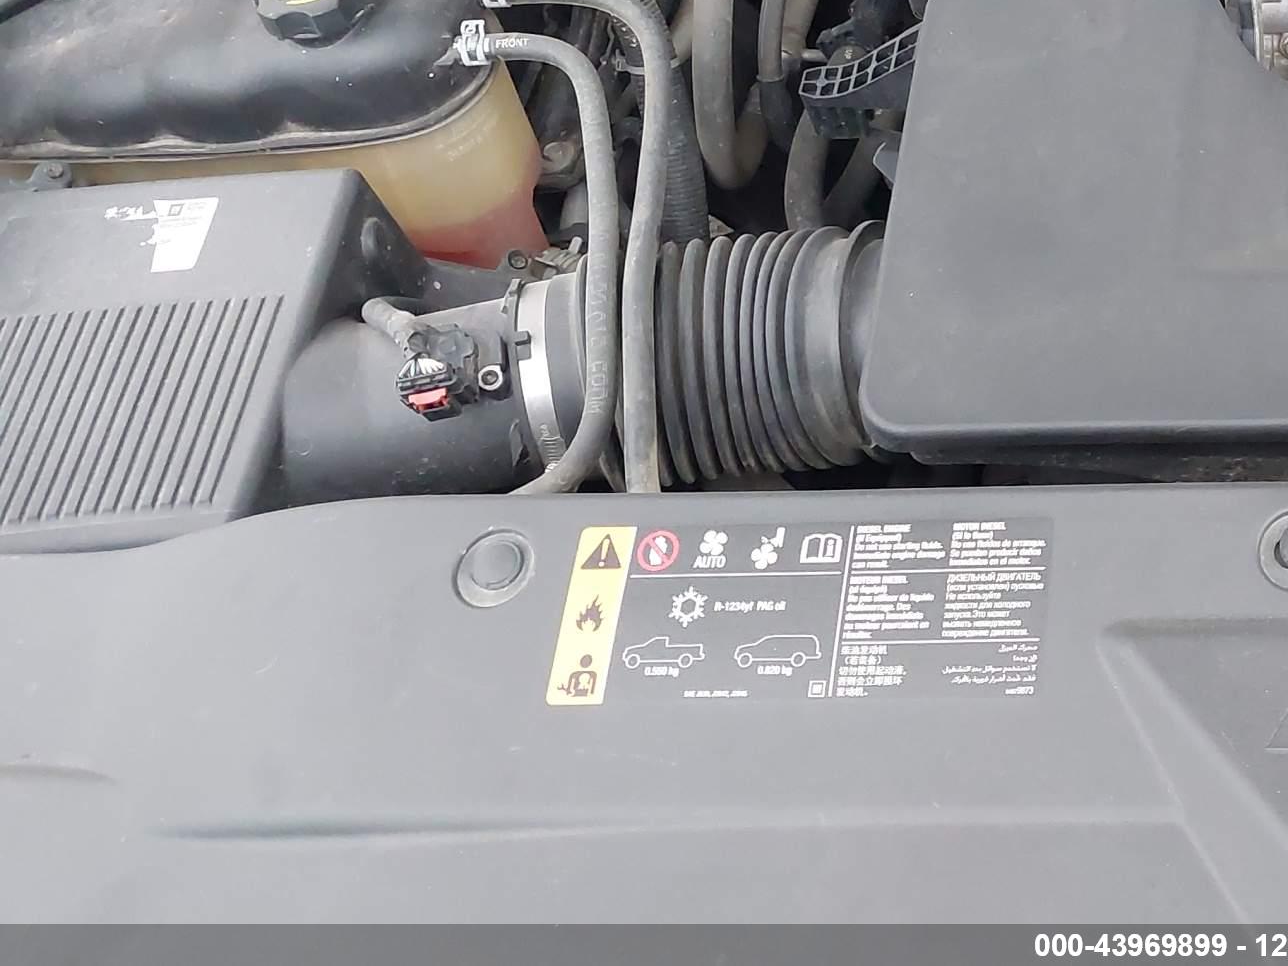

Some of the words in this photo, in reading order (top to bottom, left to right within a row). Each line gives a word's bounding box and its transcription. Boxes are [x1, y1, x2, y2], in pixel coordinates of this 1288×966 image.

[495, 37, 529, 49] FRONT
[692, 555, 727, 569] AUTO
[756, 600, 774, 612] PAG
